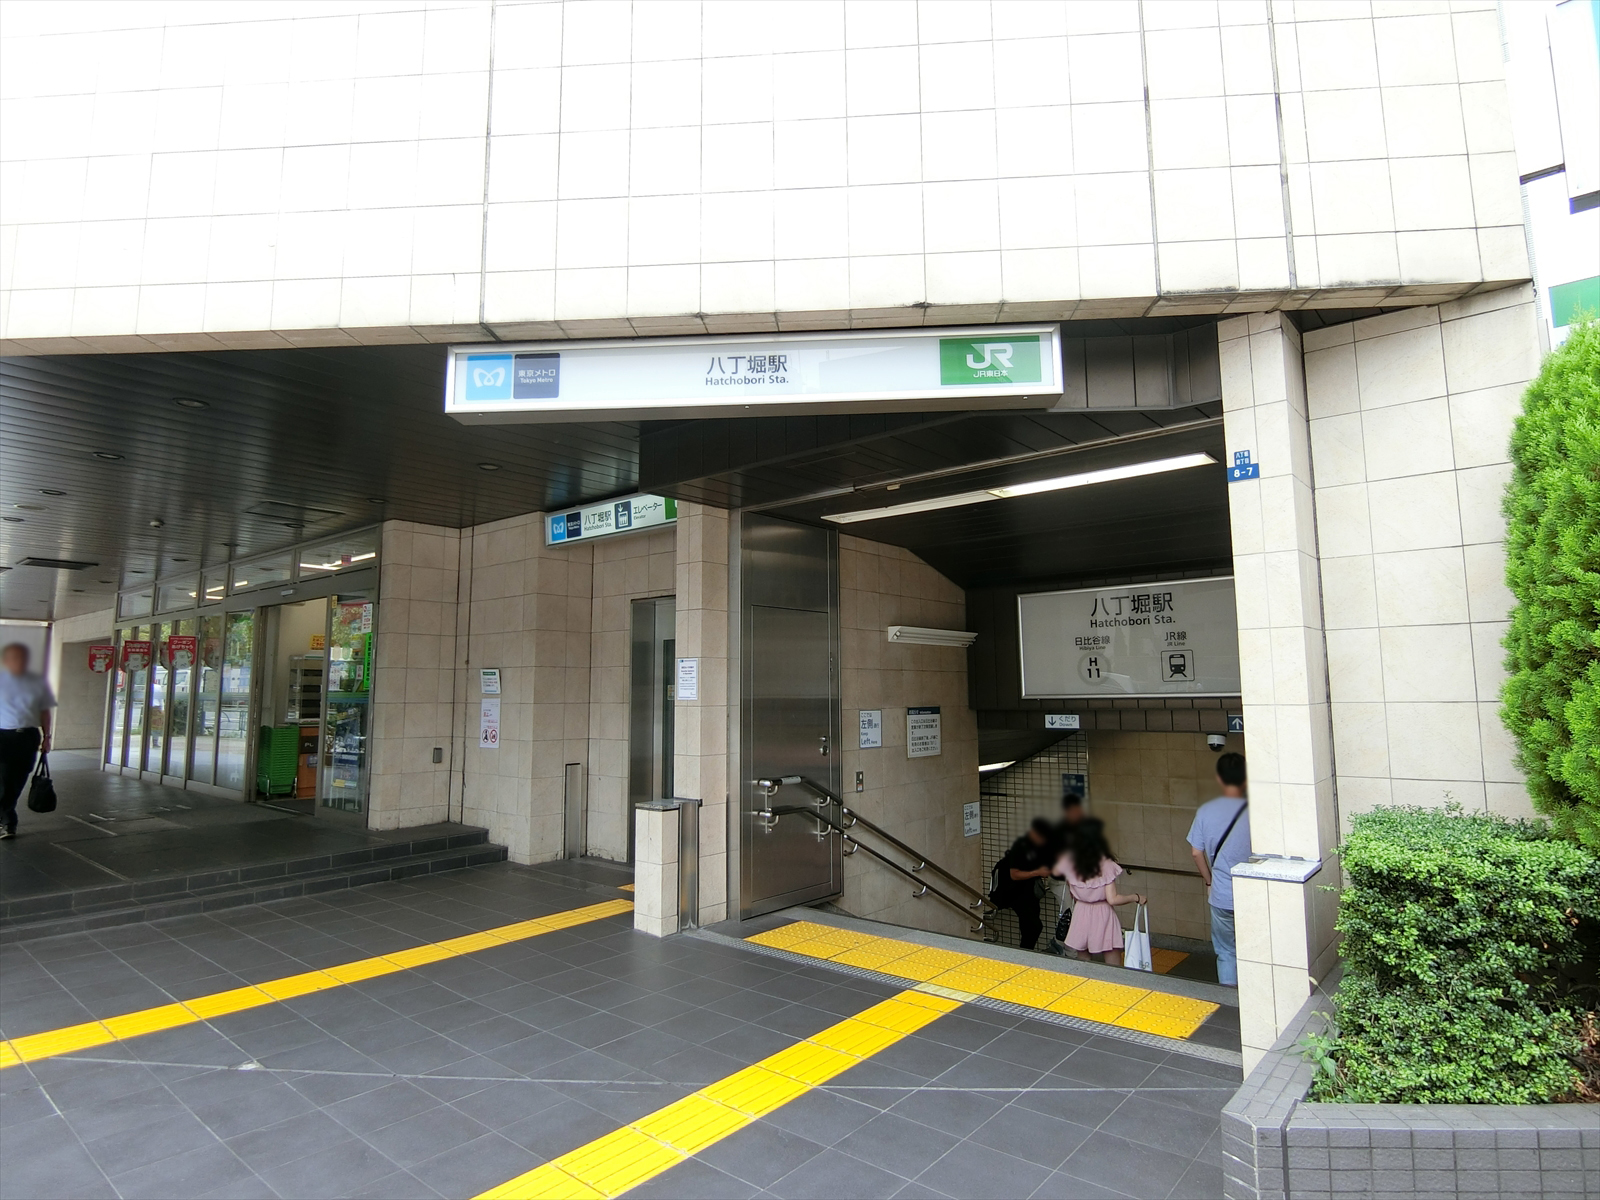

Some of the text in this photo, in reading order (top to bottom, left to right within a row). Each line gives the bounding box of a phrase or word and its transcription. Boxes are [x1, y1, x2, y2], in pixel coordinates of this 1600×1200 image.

[966, 343, 1014, 369] JR
[706, 354, 788, 375] 八丁堀駅
[518, 369, 556, 377] 東京メトロ
[973, 369, 1009, 378] JR東日本
[705, 374, 789, 386] Hatchobori Sta.
[1234, 467, 1253, 478] 8-7
[633, 502, 663, 515] エレベーター
[584, 510, 612, 526] 八丁堀駅
[583, 524, 605, 532] Hatchobori
[1090, 592, 1174, 617] 八丁堀駅
[1090, 614, 1176, 629] Hatchobori Sta.
[1075, 635, 1110, 646] 日比谷線
[1164, 631, 1187, 641] JR線
[1089, 657, 1098, 667] H
[1087, 668, 1100, 679] 11
[1058, 715, 1076, 723] くだり
[861, 737, 871, 746] Left
